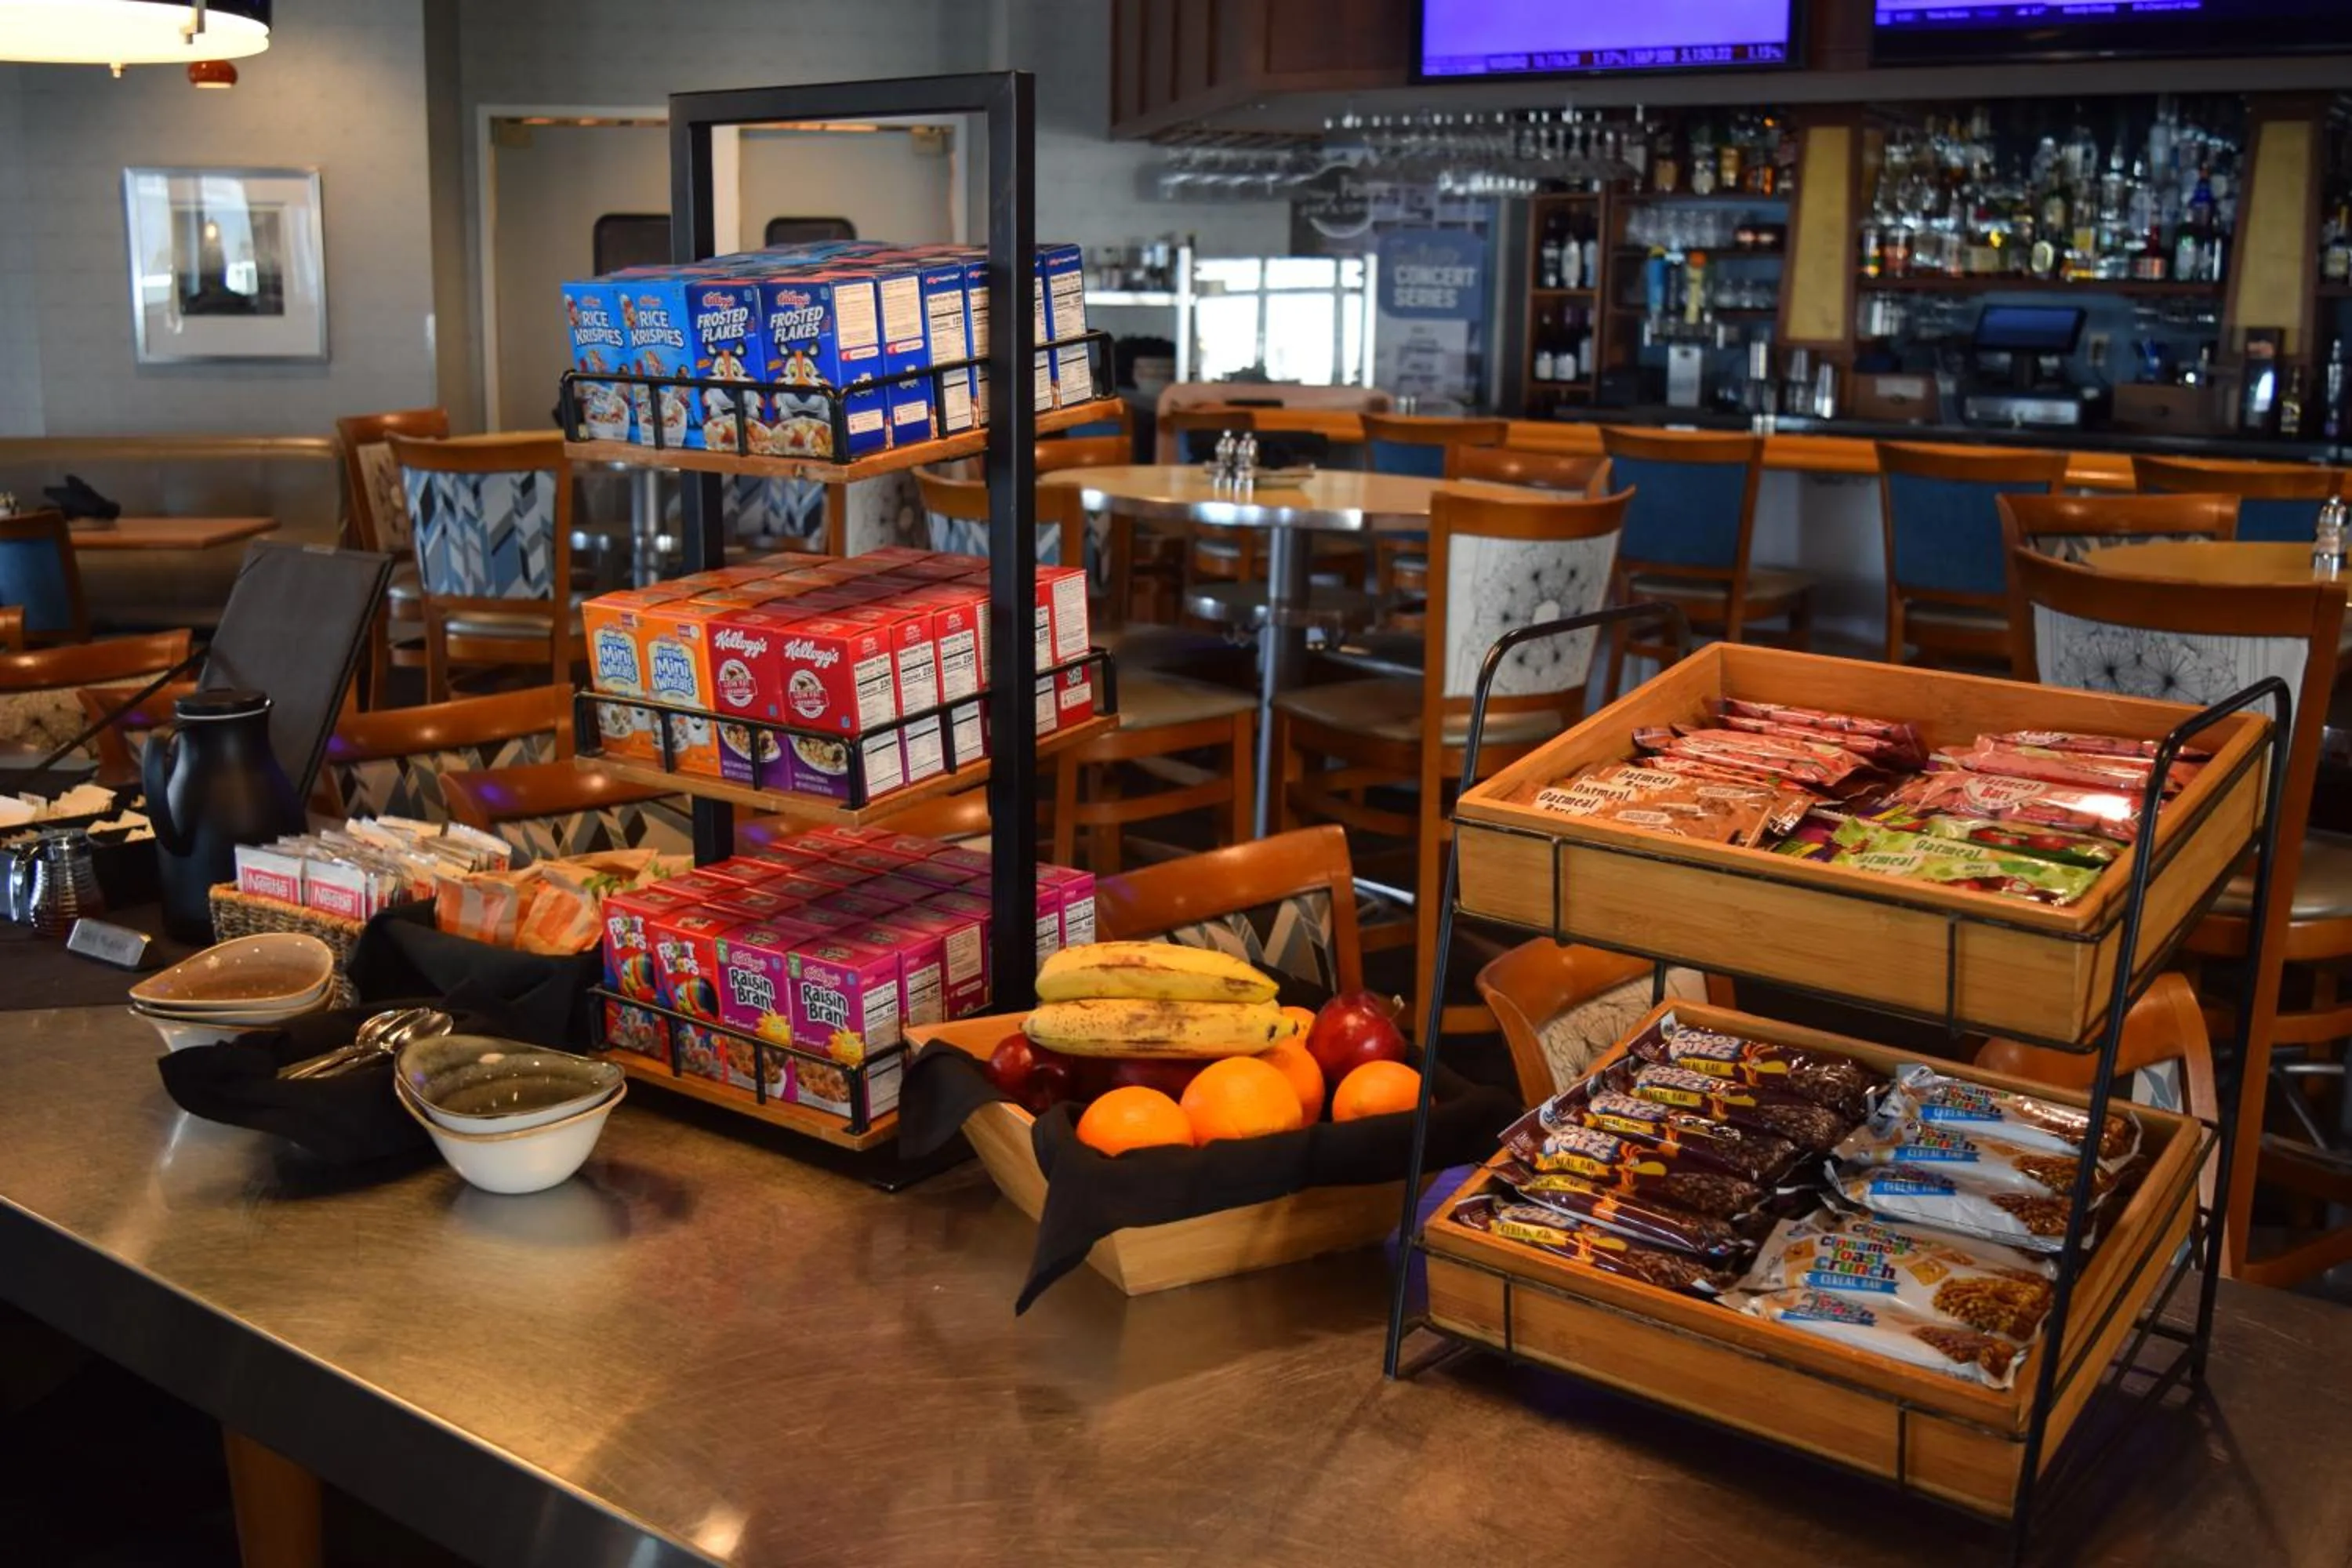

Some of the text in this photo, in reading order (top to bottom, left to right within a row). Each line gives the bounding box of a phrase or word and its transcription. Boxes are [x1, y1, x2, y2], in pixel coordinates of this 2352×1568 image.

[1394, 266, 1475, 287] CONCERT
[1393, 287, 1457, 308] SERIES
[582, 310, 609, 327] RICE
[639, 310, 669, 328] RICE
[696, 307, 749, 329] FROSTED
[770, 305, 825, 329] FROSTED
[575, 328, 624, 347] KRISPIES
[630, 328, 684, 347] KRISPIES
[702, 322, 744, 343] FLAKES
[775, 322, 820, 343] FLAKES
[714, 629, 768, 658] Kellogg's
[784, 638, 839, 668] Kellogg's
[601, 644, 633, 666] Mini
[655, 657, 691, 677] Mini
[1618, 768, 1677, 785] Oatmeal
[1539, 791, 1599, 808] Oatmeal
[1573, 783, 1632, 800] Oatmeal
[1980, 786, 2010, 800] Bars
[1915, 839, 1983, 858] Oatmeal
[608, 916, 644, 934] FROOT
[614, 931, 647, 949] LOOPS
[657, 941, 695, 959] FROOT
[664, 956, 699, 975] LOOPS
[730, 967, 775, 998] Raisin
[737, 985, 772, 1011] Bran
[802, 982, 849, 1017] Raisin
[808, 1001, 847, 1029] Bran
[1820, 1273, 1856, 1287] CEREAL
